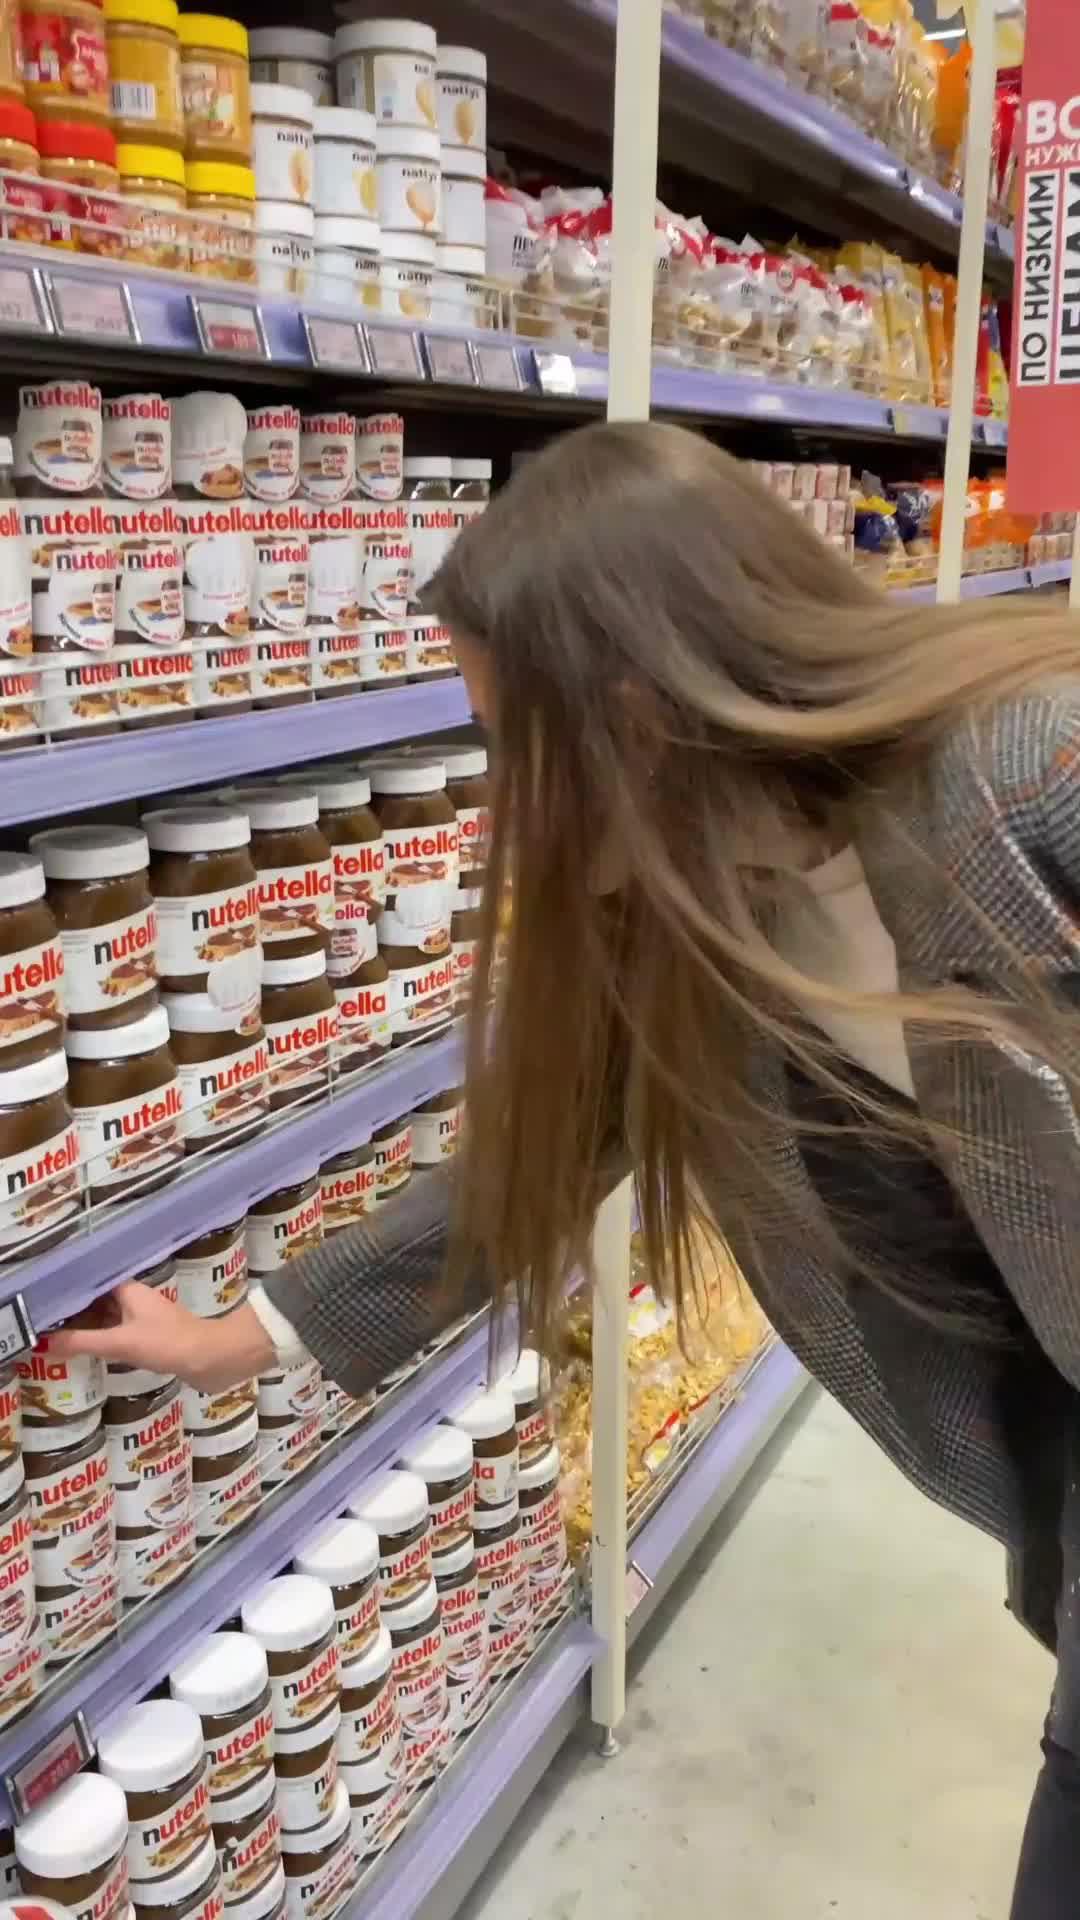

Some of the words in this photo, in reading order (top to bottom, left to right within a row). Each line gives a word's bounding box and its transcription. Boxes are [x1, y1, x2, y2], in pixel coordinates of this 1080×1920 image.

[1025, 143, 1080, 167] НУЖ
[1024, 173, 1056, 321] НИЗКИМ
[1020, 332, 1047, 382] ПО
[23, 386, 100, 408] nutella
[24, 506, 116, 535] nutella
[258, 869, 332, 904] utella
